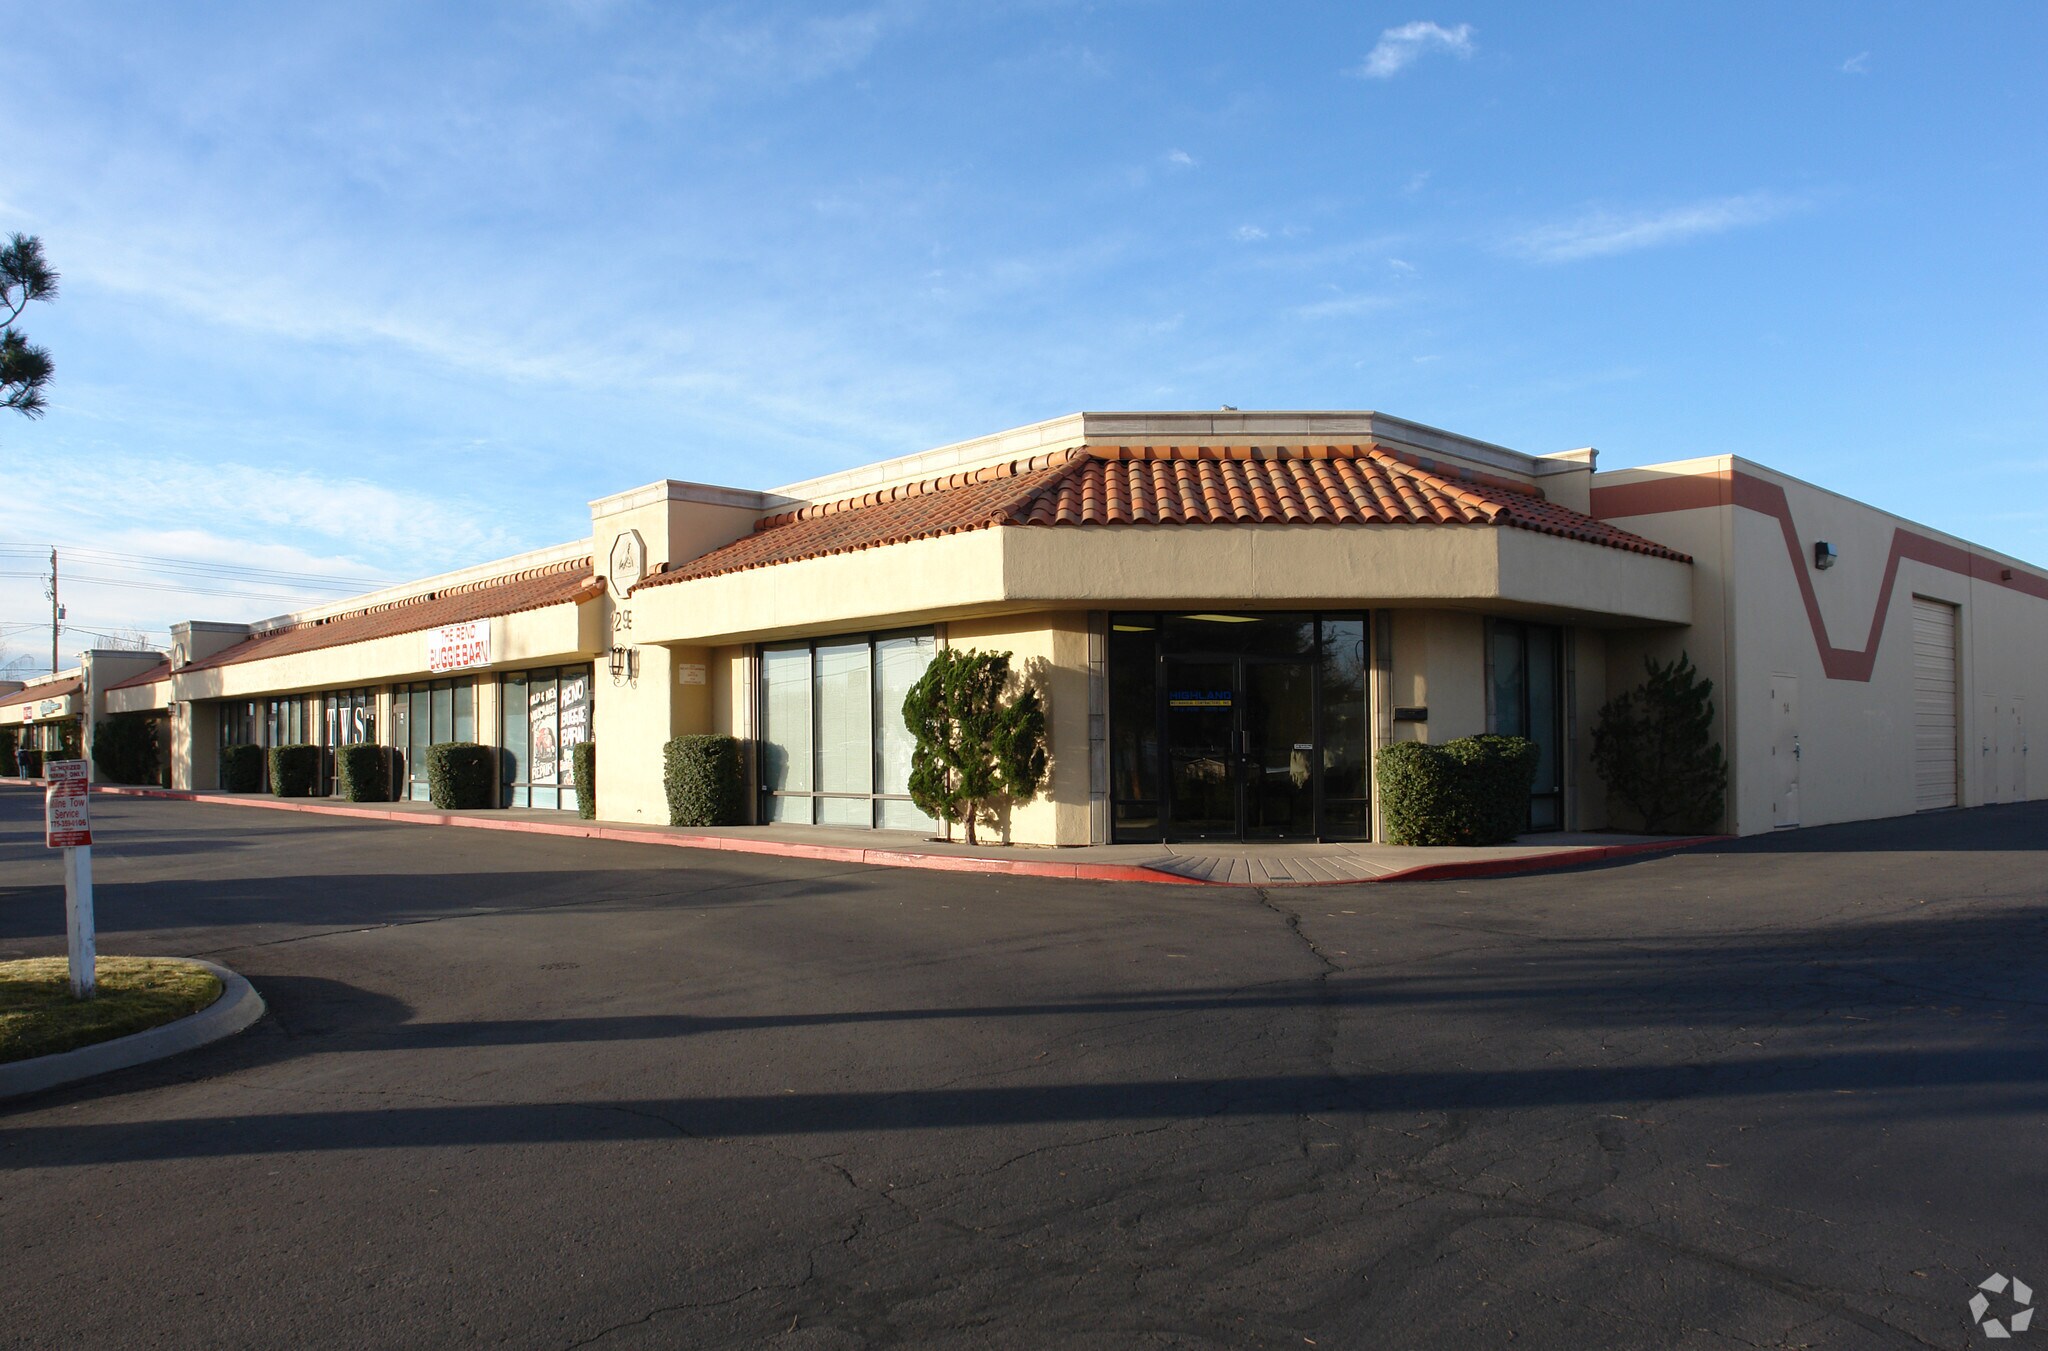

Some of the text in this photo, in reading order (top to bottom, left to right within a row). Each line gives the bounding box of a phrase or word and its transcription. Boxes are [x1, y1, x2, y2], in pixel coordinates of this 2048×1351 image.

[441, 623, 475, 643] THE RENO
[530, 692, 540, 706] OLD
[561, 680, 584, 708] RENO
[1169, 691, 1232, 700] HIGHLAND
[561, 725, 584, 747] BARN
[70, 797, 85, 808] Tow
[55, 809, 80, 819] Service
